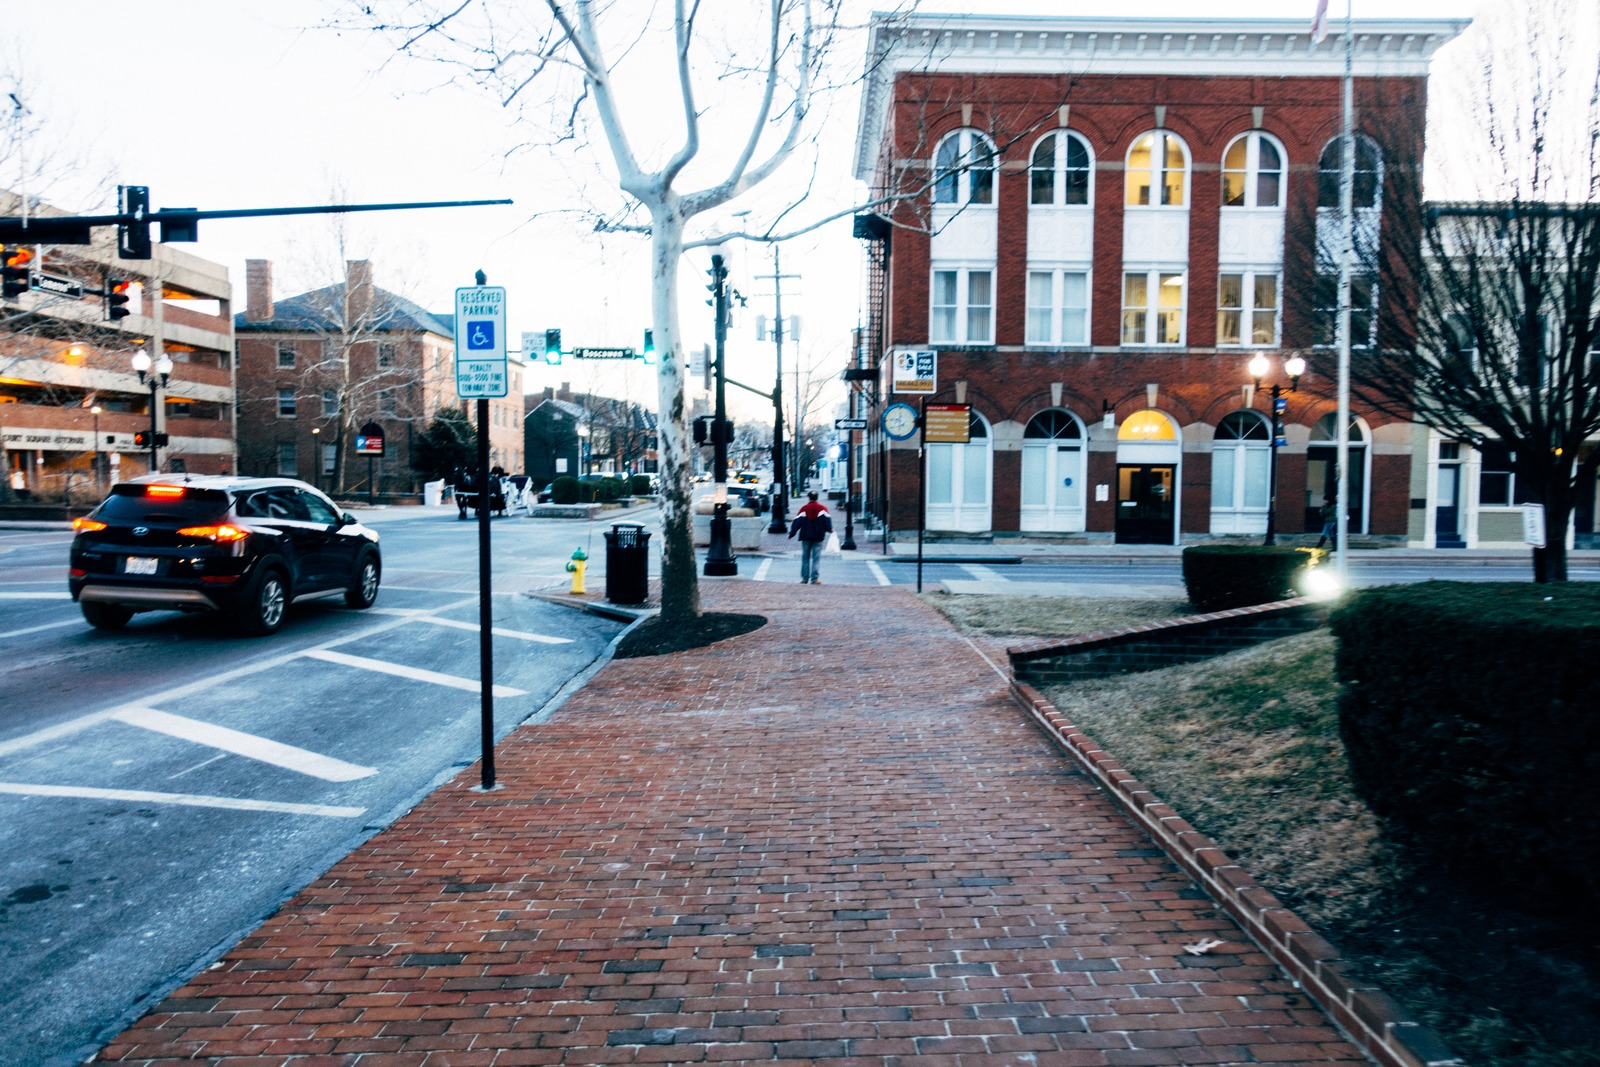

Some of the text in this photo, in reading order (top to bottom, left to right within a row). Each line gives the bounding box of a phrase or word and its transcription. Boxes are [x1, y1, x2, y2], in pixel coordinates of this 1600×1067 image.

[460, 292, 502, 304] RESERVED
[463, 305, 499, 316] PARKING
[469, 363, 492, 373] PENALTY
[490, 373, 503, 382] FINE
[488, 383, 501, 392] ZONE
